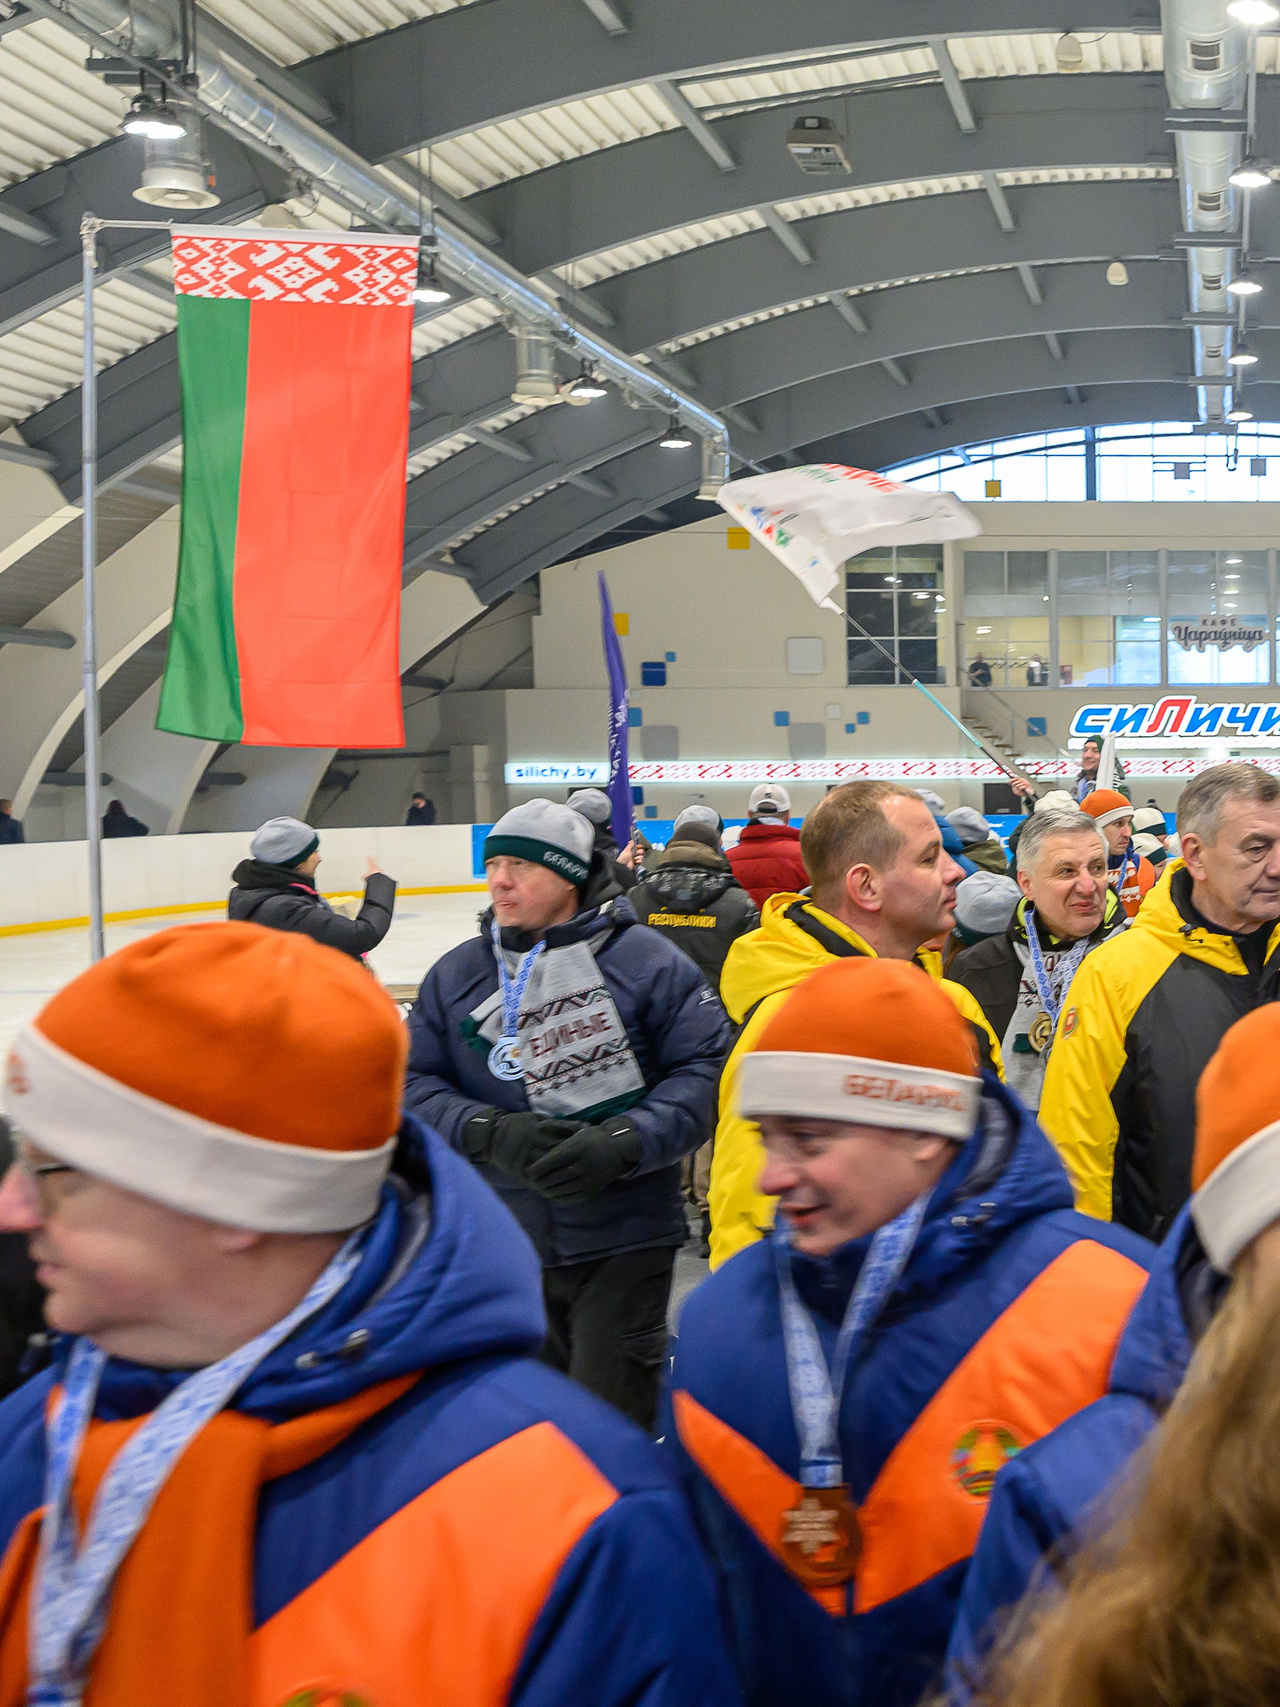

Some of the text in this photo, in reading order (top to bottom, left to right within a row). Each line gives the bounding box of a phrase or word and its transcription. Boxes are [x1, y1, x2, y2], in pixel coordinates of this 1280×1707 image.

[1201, 617, 1237, 627] КАФЕ
[515, 765, 598, 780] silichy.by
[647, 913, 717, 929] РЕСПУБЛИКИ
[529, 1010, 613, 1059] ЕДИНЫЕ
